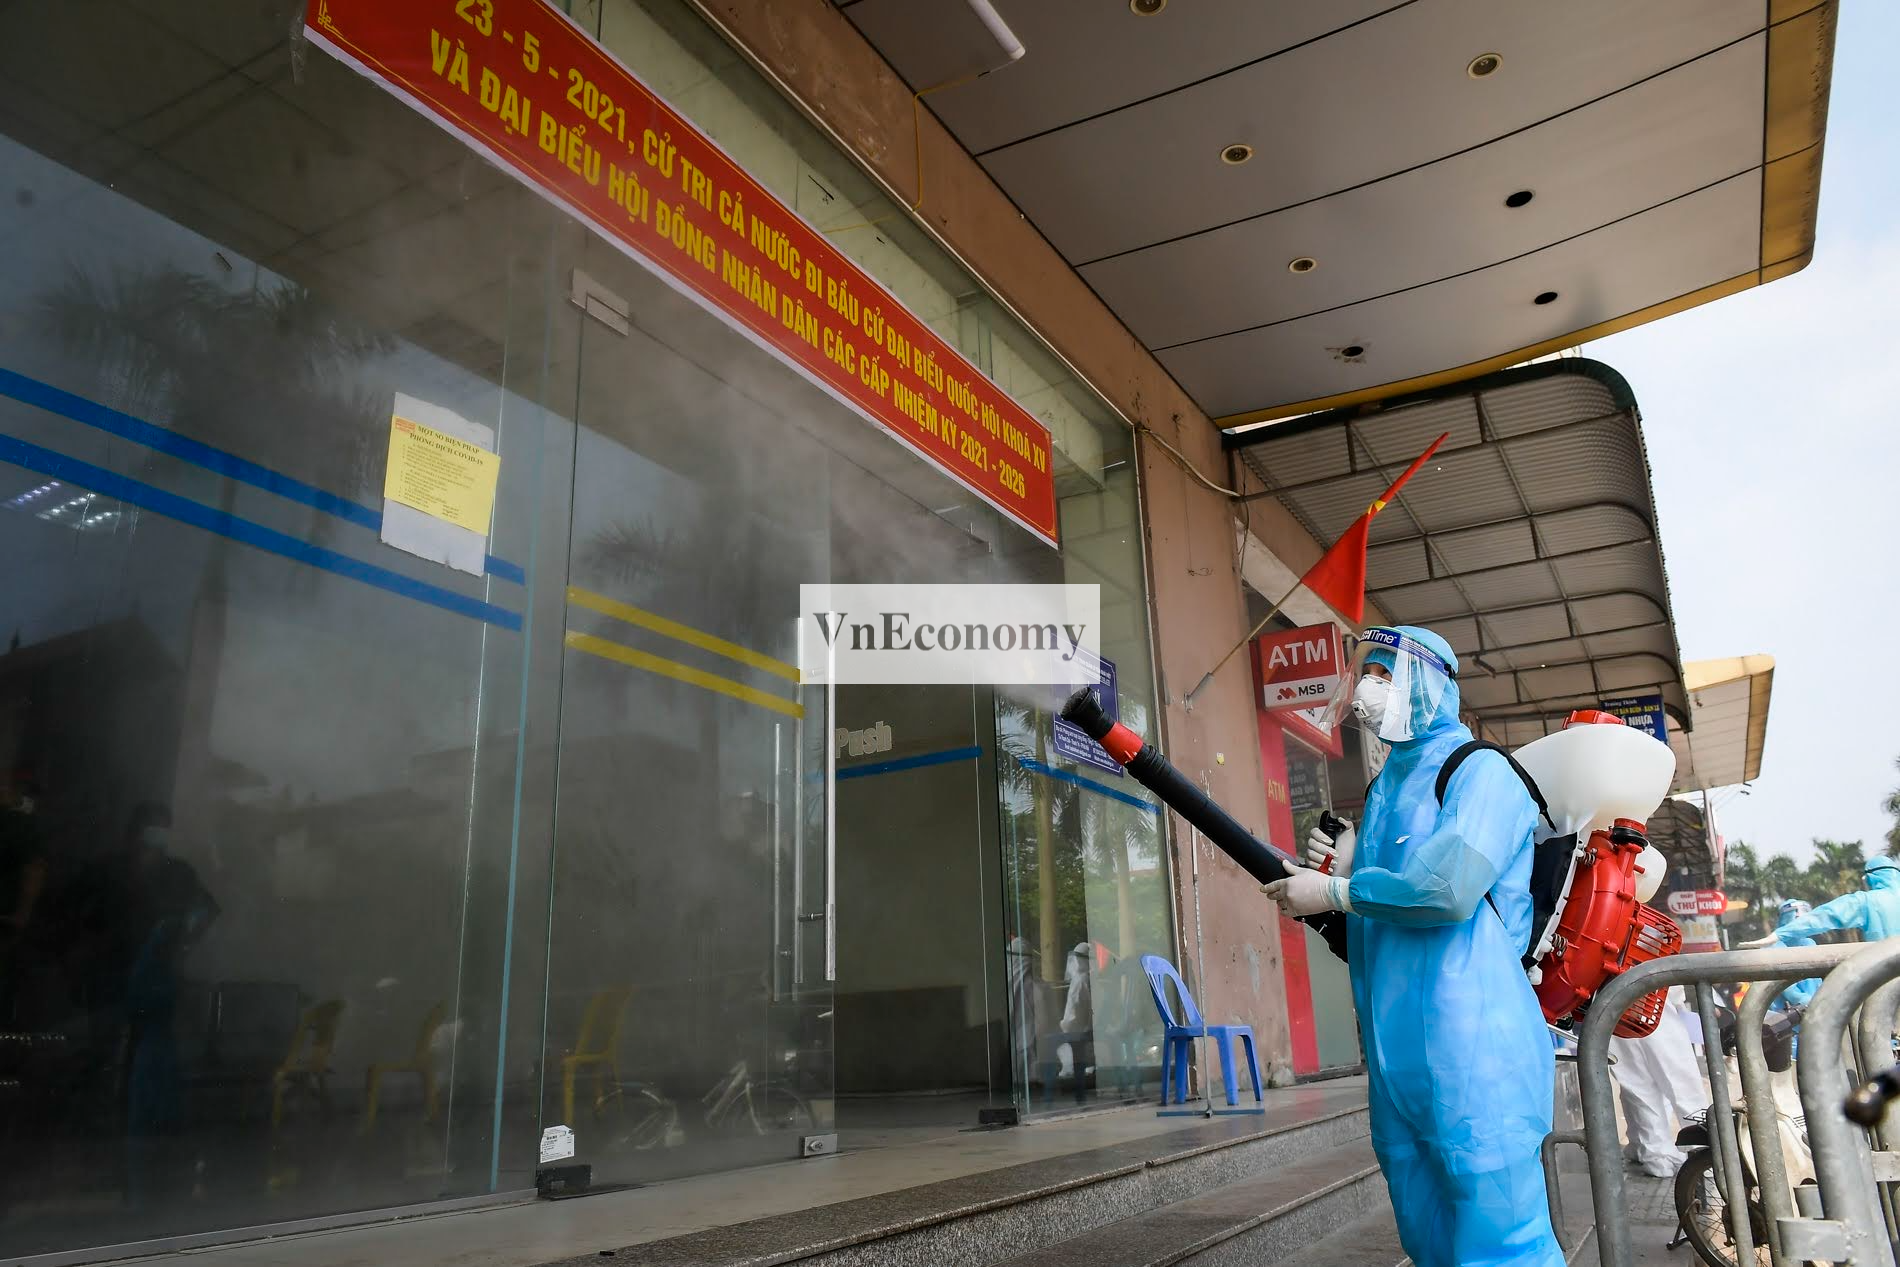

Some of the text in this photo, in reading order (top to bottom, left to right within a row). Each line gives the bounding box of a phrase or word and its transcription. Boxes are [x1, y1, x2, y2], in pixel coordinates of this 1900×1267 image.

[431, 29, 470, 96] VÀ
[480, 67, 530, 137] ĐẠI
[539, 111, 600, 187] BIỂU
[608, 163, 648, 226] HỘI
[656, 199, 716, 272] ĐỒNG
[722, 252, 777, 319] NHÂN
[782, 295, 819, 350] DÂN
[824, 326, 855, 376] CÁC
[860, 355, 890, 399] CẤP
[894, 378, 938, 437] NHIỆM
[941, 414, 957, 450] KỲ
[960, 430, 988, 473] 2021
[999, 459, 1026, 500] 2026
[523, 31, 540, 73] 5
[643, 129, 676, 178] CỬ
[681, 156, 713, 211] TRI
[719, 190, 744, 238] CẢ
[751, 215, 801, 279] NƯỚC
[805, 263, 823, 299] ĐI
[828, 278, 858, 327] BẦU
[863, 307, 884, 347] CỬ
[887, 325, 911, 369] ĐẠI
[914, 347, 943, 394] BIỂU
[947, 374, 979, 421] QUỐC
[981, 401, 1000, 441] HỘI
[1003, 419, 1030, 465] KHOÁ
[1033, 442, 1045, 473] XV
[1268, 638, 1328, 670] ATM
[1298, 684, 1325, 697] MSB
[834, 721, 892, 759] Push
[1268, 778, 1286, 806] ATM
